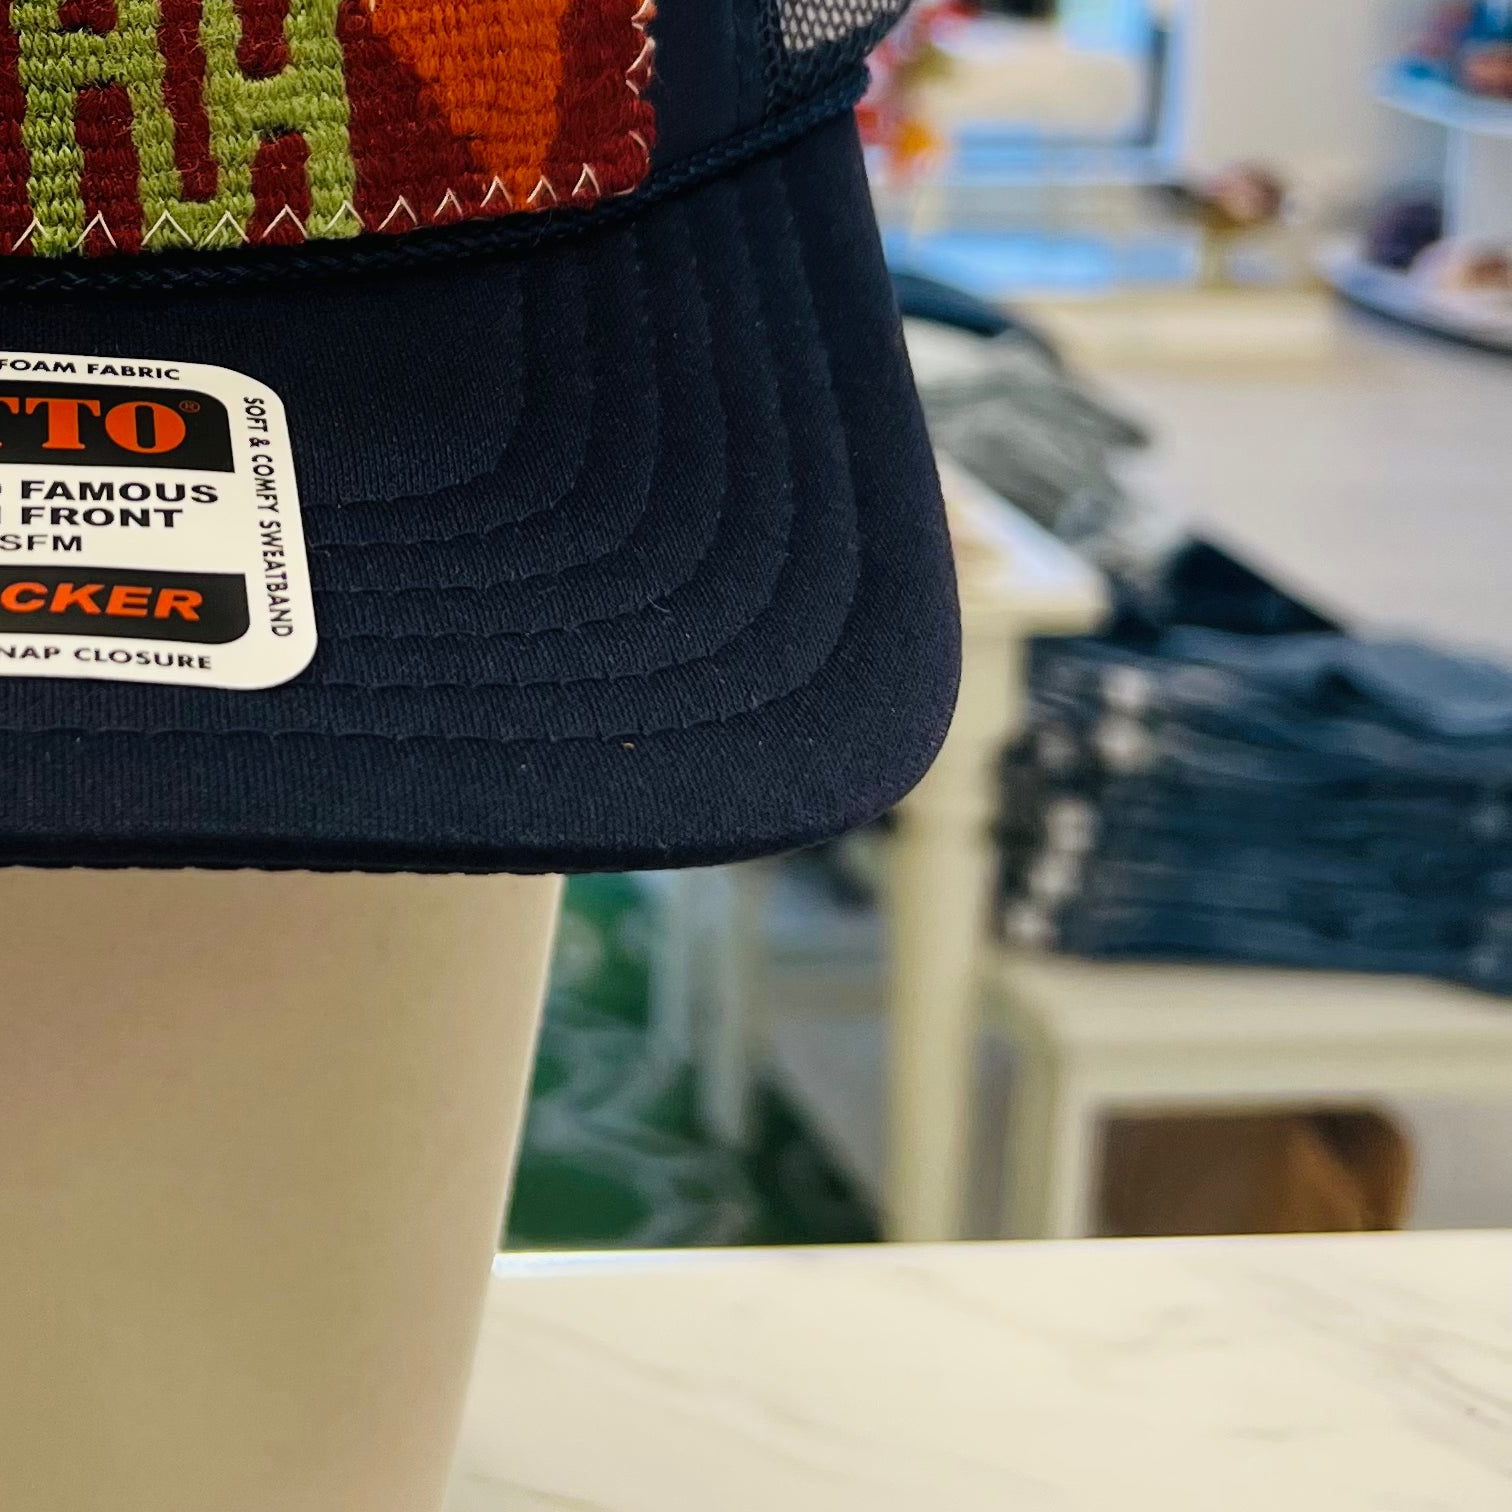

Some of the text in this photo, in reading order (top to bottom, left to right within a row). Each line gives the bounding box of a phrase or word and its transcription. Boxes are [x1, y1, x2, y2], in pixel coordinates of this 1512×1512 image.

[88, 362, 180, 380] FABRIC
[22, 480, 218, 503] FAMOUS
[22, 507, 182, 527] FRONT
[244, 397, 293, 636] SOFT & COMFY SWEATBAND
[74, 649, 211, 669] CLOSURE
